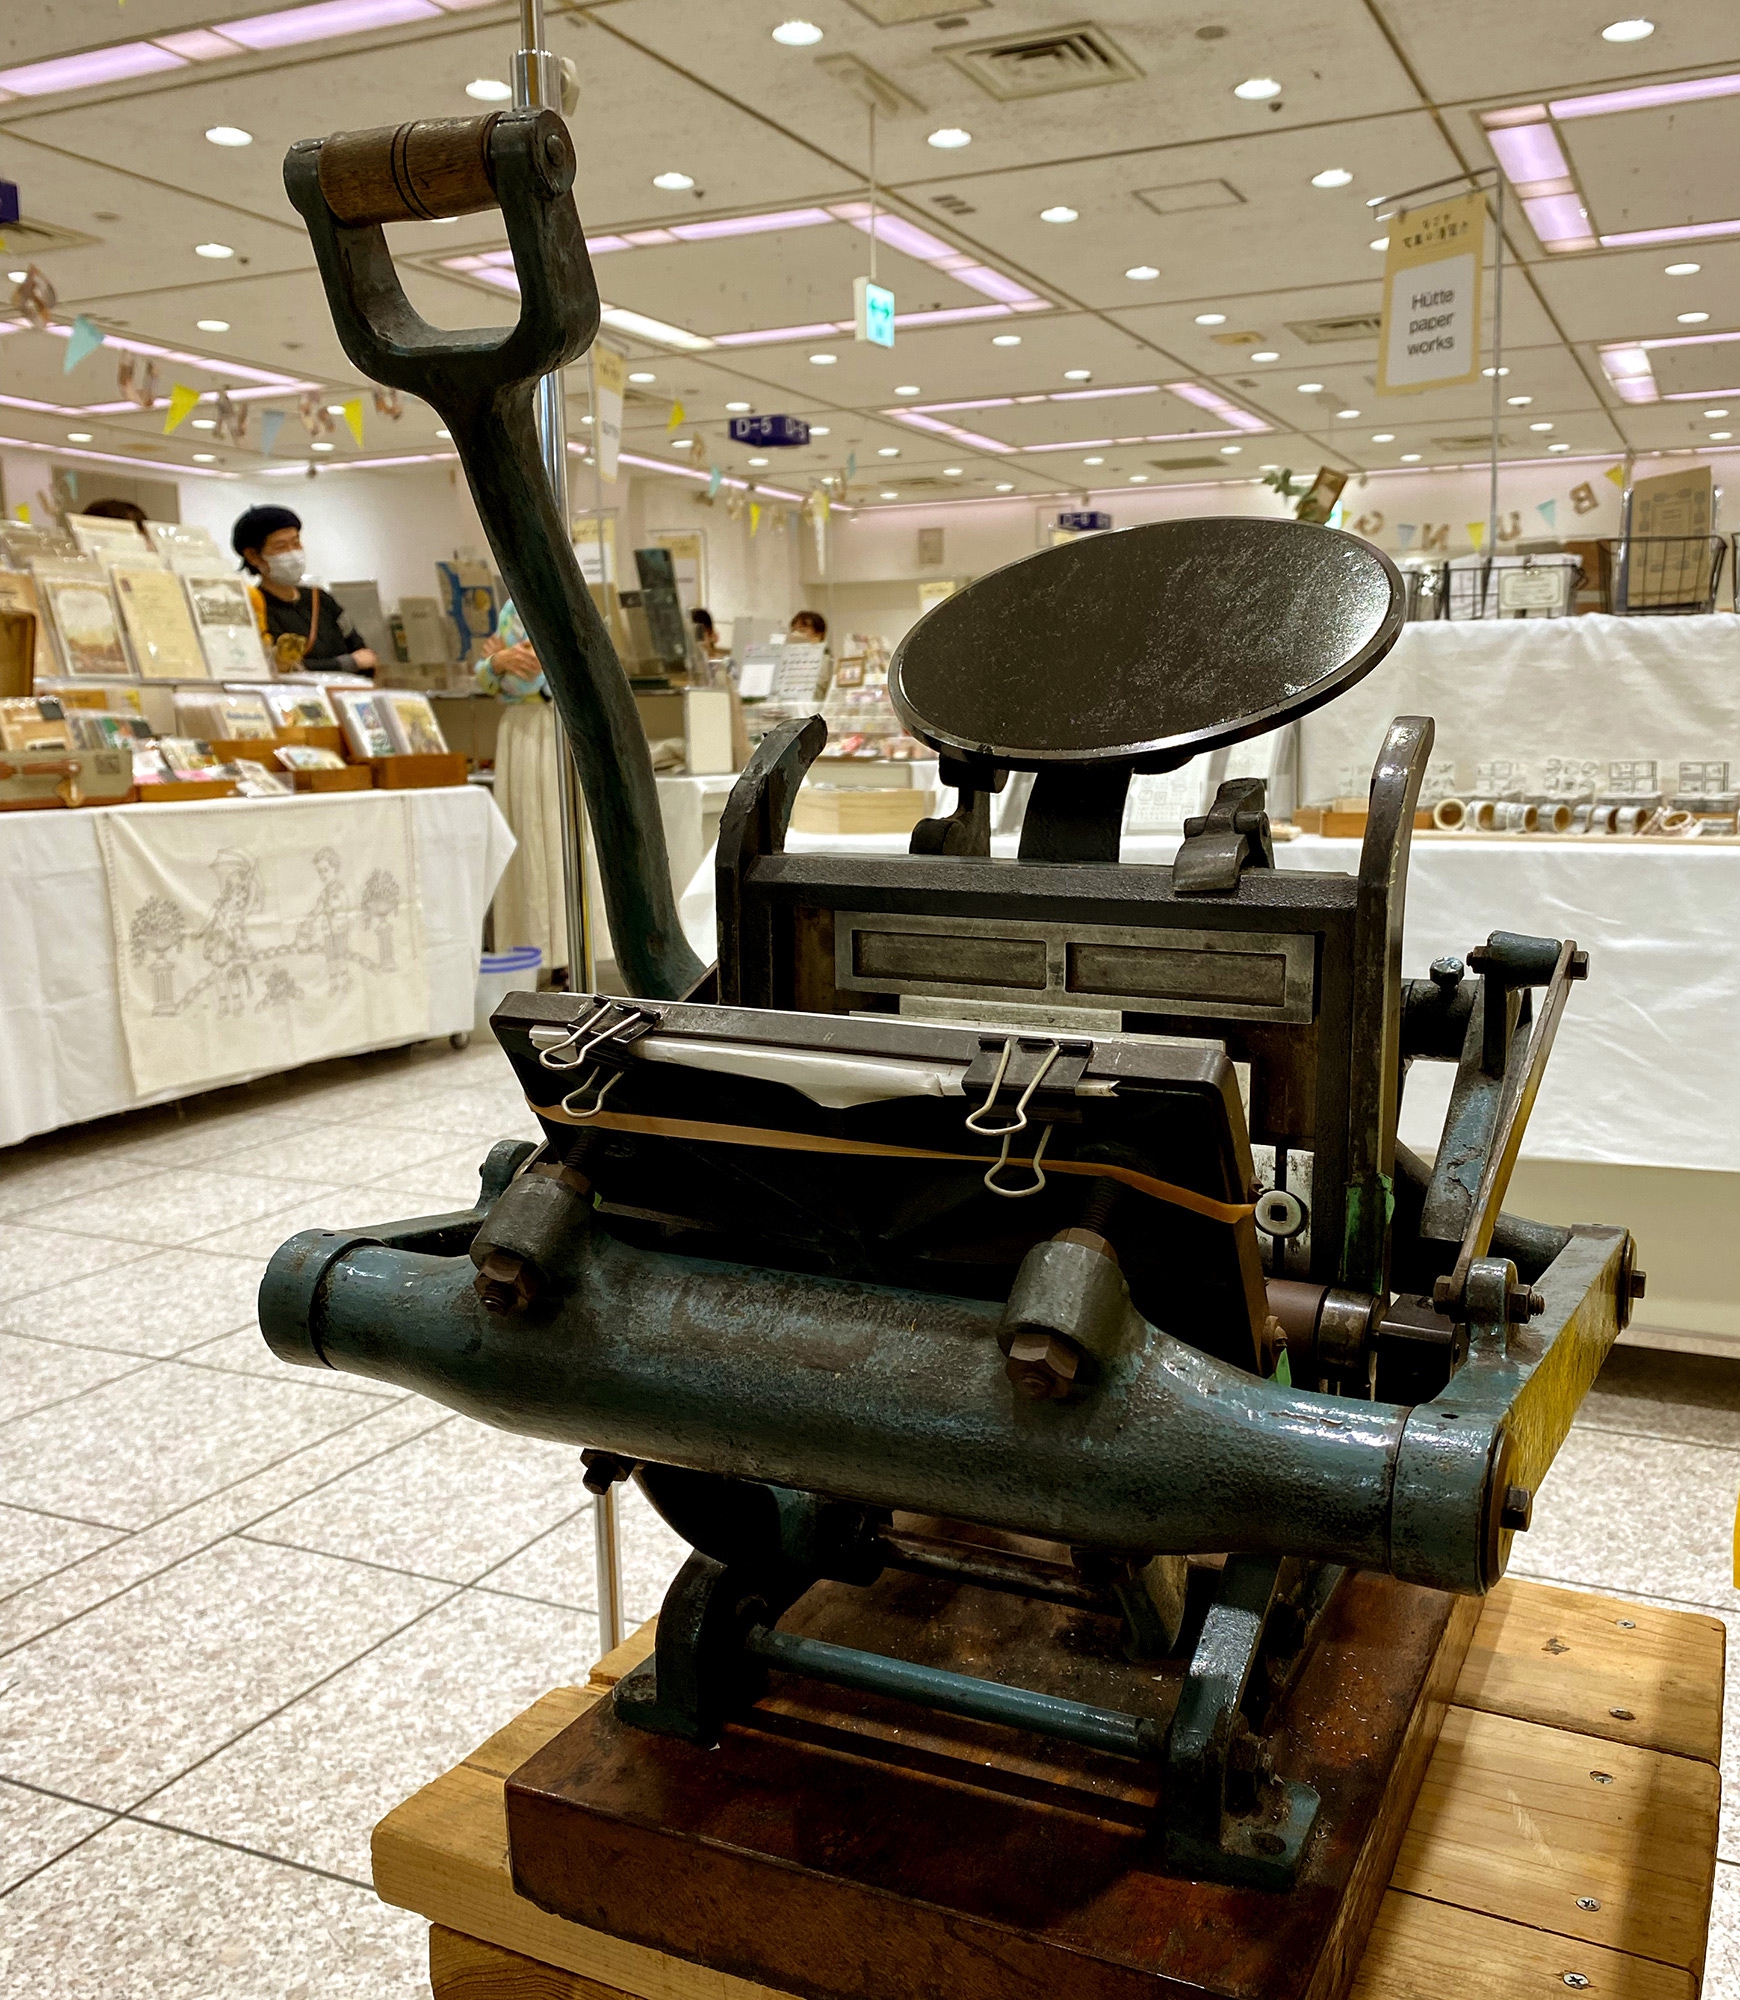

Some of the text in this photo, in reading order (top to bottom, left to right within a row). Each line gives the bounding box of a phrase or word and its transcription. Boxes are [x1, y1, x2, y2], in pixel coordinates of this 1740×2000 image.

[1412, 289, 1454, 312] Hütte
[1409, 312, 1455, 336] paper
[1407, 336, 1454, 356] works
[736, 416, 773, 438] D-5
